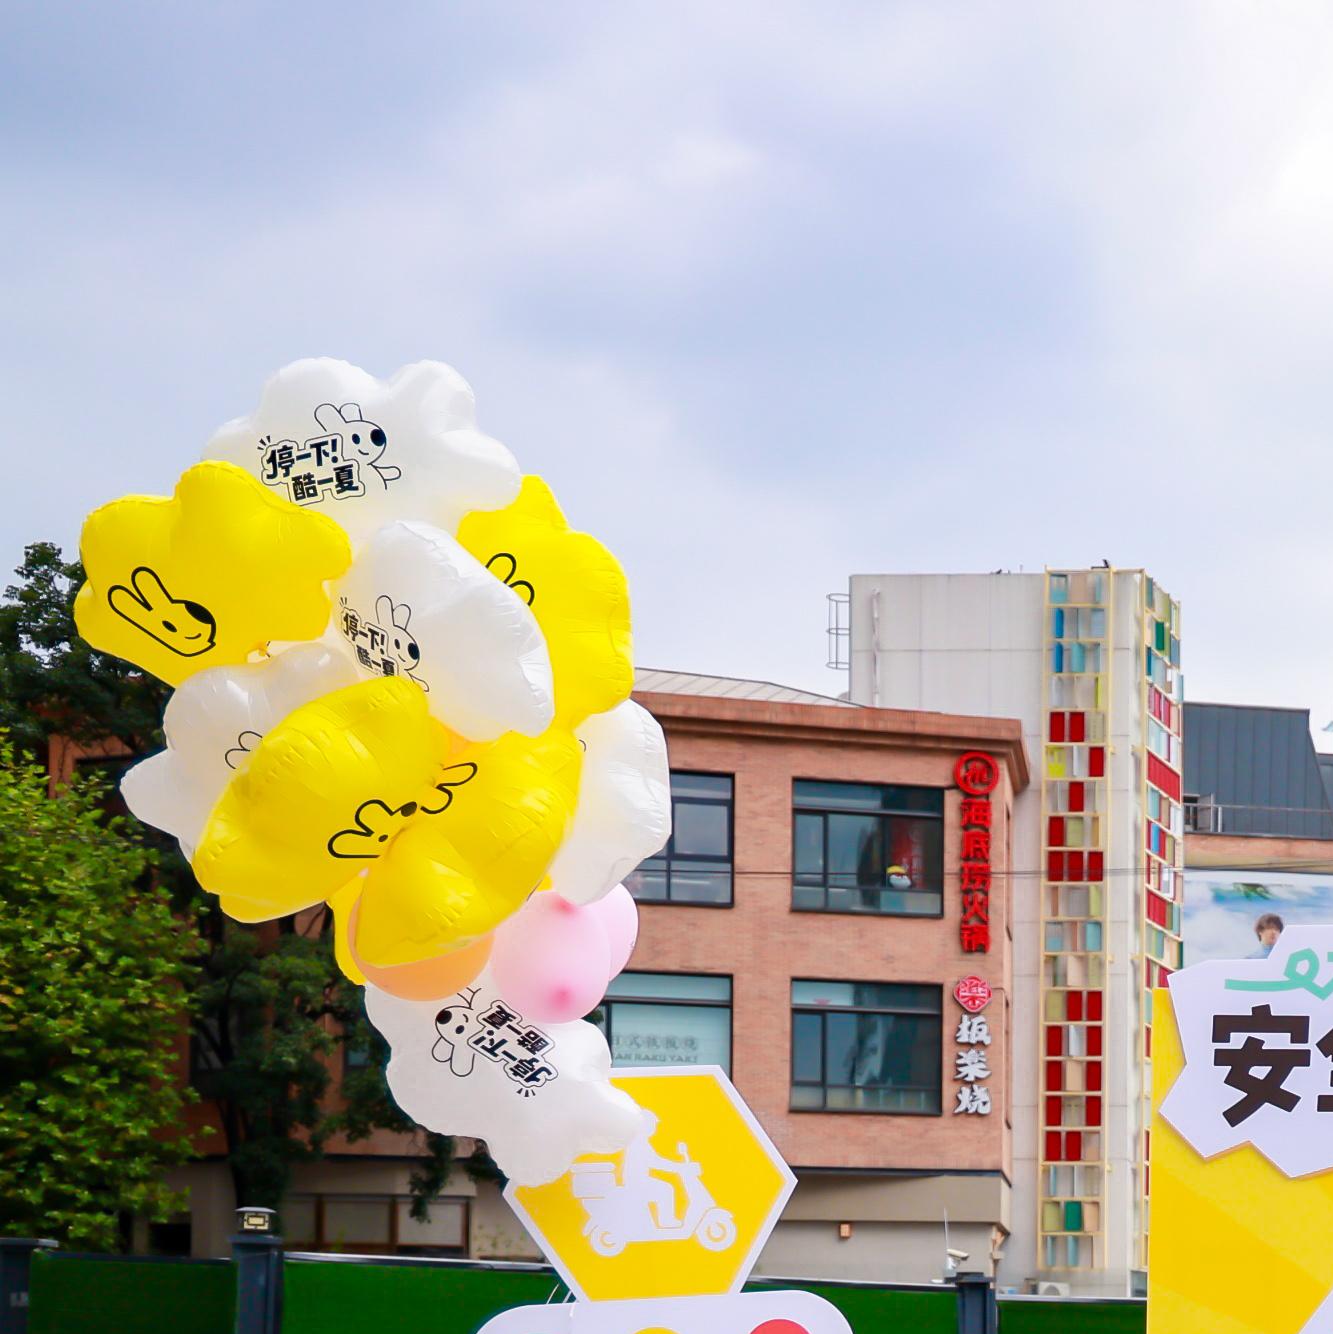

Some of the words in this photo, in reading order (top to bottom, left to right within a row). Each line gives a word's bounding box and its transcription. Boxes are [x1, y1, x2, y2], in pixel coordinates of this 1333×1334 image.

[266, 439, 339, 480] 停一下!
[291, 464, 359, 501] 酷一夏
[343, 612, 386, 655] 停一下!
[960, 798, 992, 954] 海底捞火锅
[482, 1004, 550, 1056] 酷一夏
[473, 1028, 553, 1083] 停一下!
